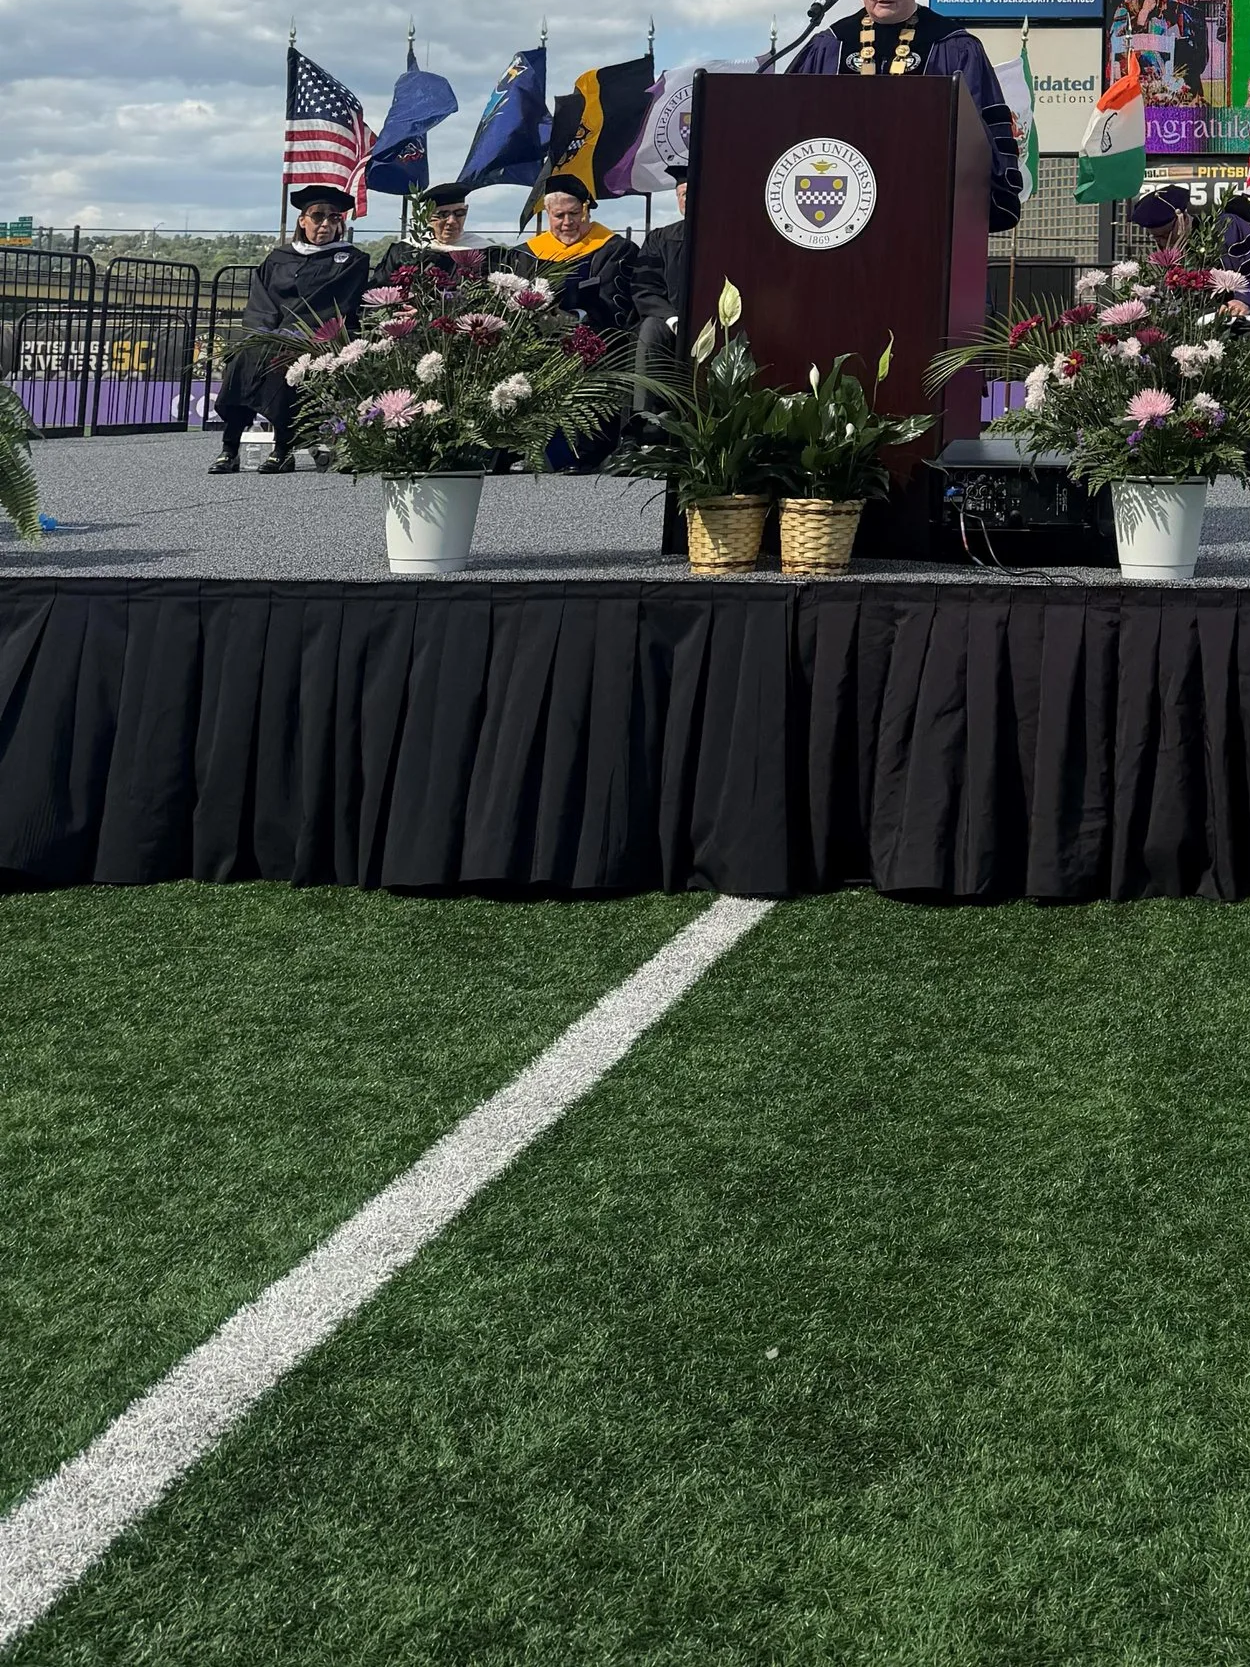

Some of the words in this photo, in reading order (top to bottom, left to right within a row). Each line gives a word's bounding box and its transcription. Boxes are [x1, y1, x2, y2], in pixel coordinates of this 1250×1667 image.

[1034, 75, 1095, 91] idated
[1038, 94, 1094, 103] cations
[1198, 166, 1248, 178] PITTSB
[770, 144, 814, 213] CHATHAM
[821, 142, 872, 215] UNIVERSITY
[808, 235, 830, 244] 1869
